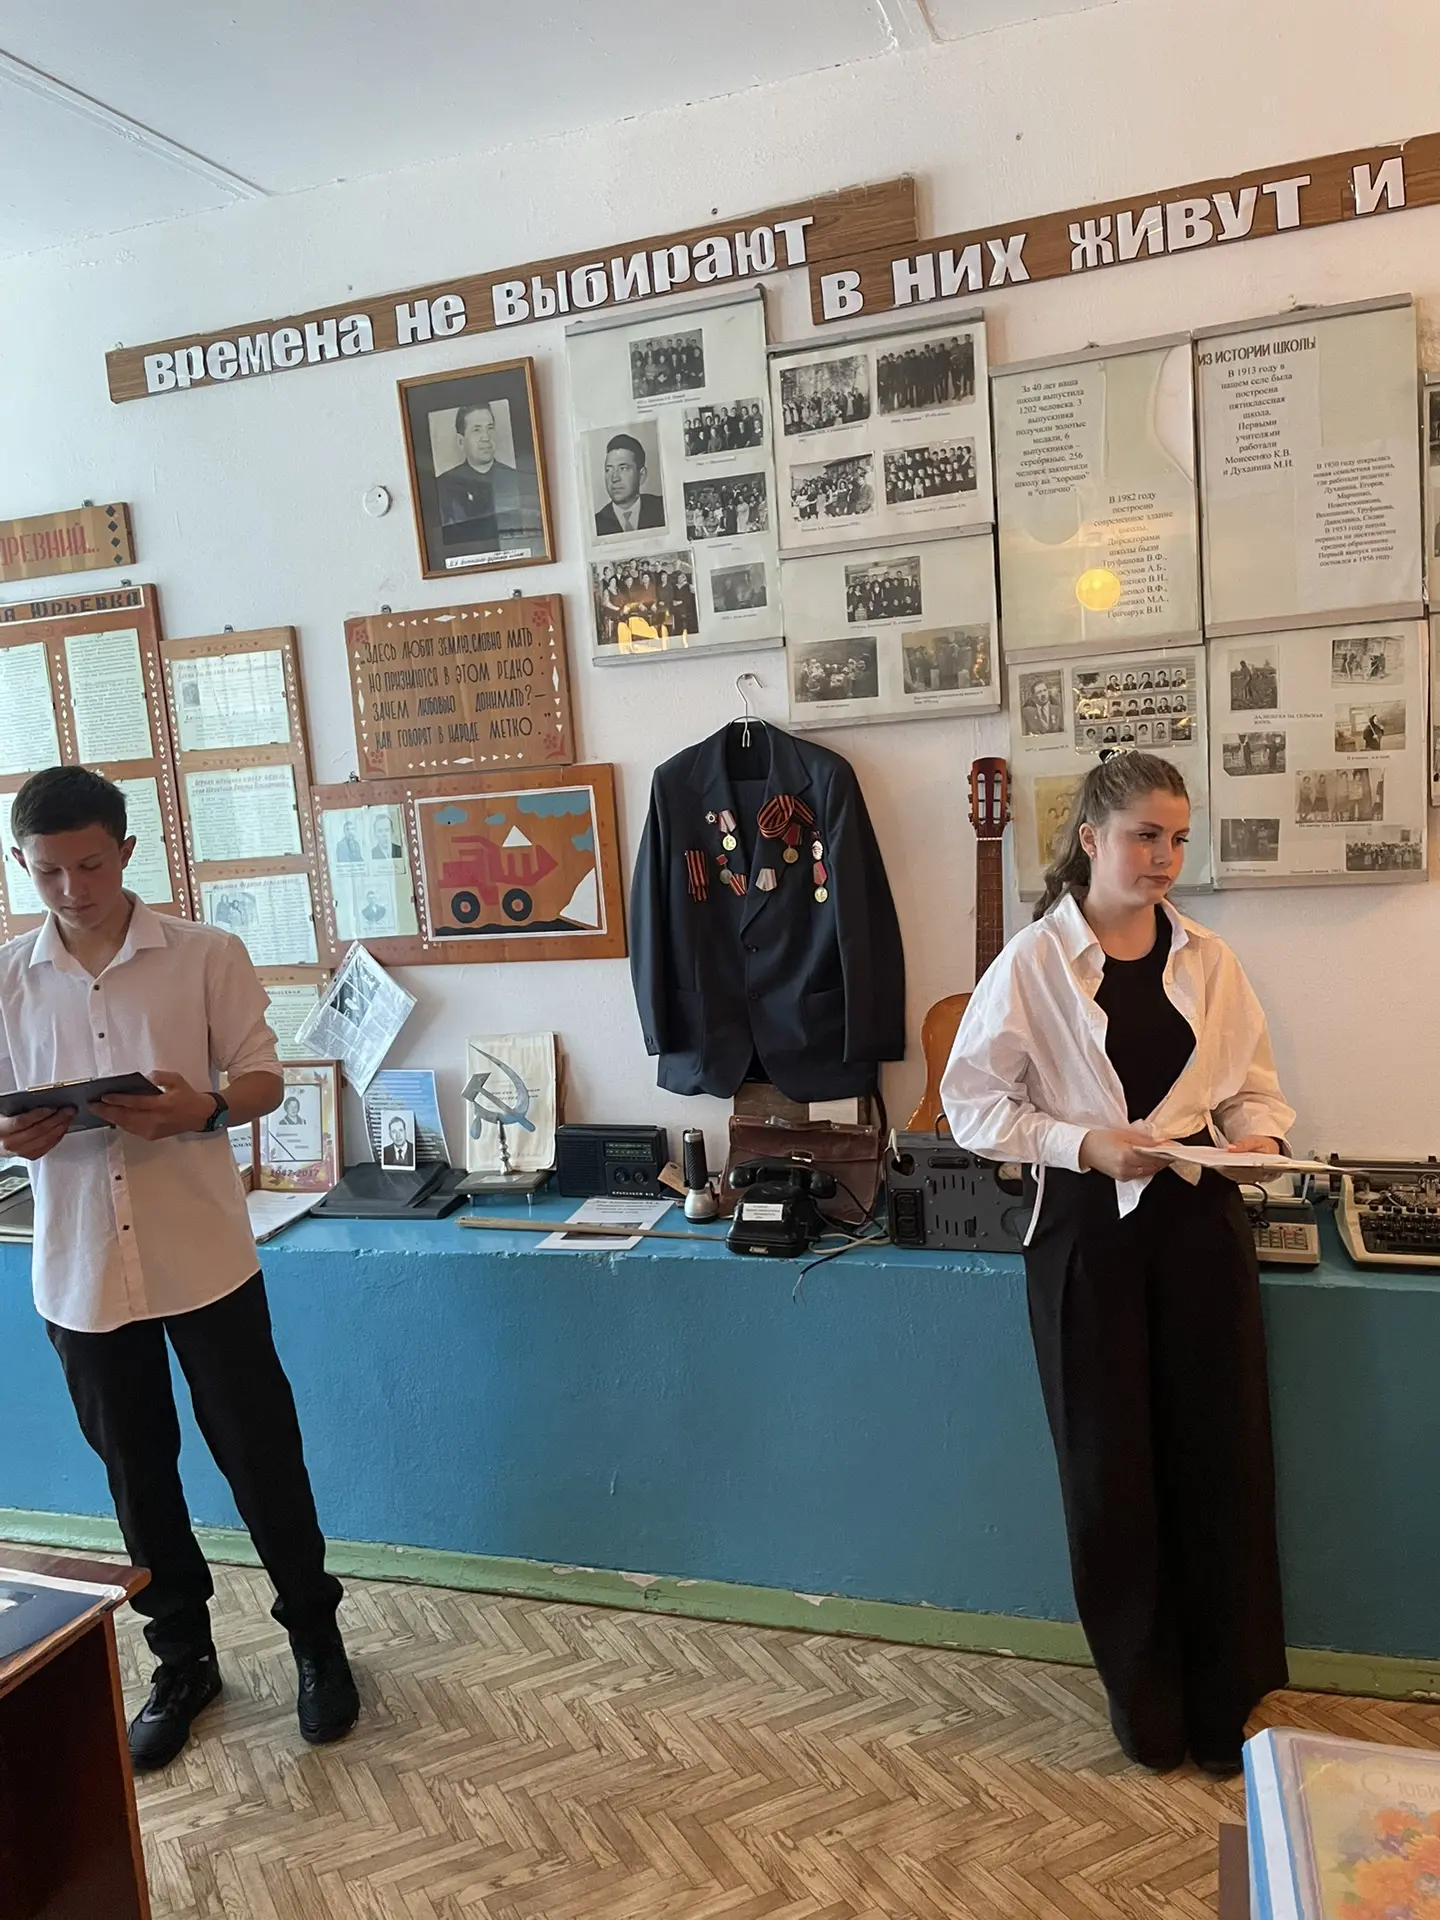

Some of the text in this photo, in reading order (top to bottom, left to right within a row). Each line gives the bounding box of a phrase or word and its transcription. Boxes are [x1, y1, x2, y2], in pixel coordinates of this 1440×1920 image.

[394, 293, 467, 345] не
[1198, 336, 1316, 366] ИЗ ИСТОРИИ ШКОЛЫ
[1237, 367, 1256, 376] 1913
[1259, 365, 1277, 374] году
[1021, 385, 1030, 393] За
[1032, 383, 1041, 391] 40
[1221, 374, 1293, 390] нашем селе была
[1042, 389, 1084, 401] выпустила
[1235, 387, 1278, 399] построена
[1229, 397, 1285, 410] пятиклассная
[1020, 406, 1037, 414] 1202
[1028, 412, 1074, 424] выпускника
[1238, 420, 1276, 431] Первыми
[1064, 432, 1070, 440] 6
[1236, 430, 1280, 443] учителями
[1239, 441, 1277, 453] работали
[1069, 452, 1083, 460] 256
[1108, 492, 1156, 504] В 1982 году
[402, 638, 434, 659] ЛЮБЯТ
[368, 673, 382, 693] НО
[444, 666, 450, 685] В
[456, 662, 490, 683] ЭТОМ
[372, 700, 409, 721] ЗАЧЕМ
[375, 730, 392, 749] КАК
[397, 726, 432, 748] ГОВОРЯТ
[438, 725, 444, 744] В
[448, 721, 480, 743] НАРОДЕ
